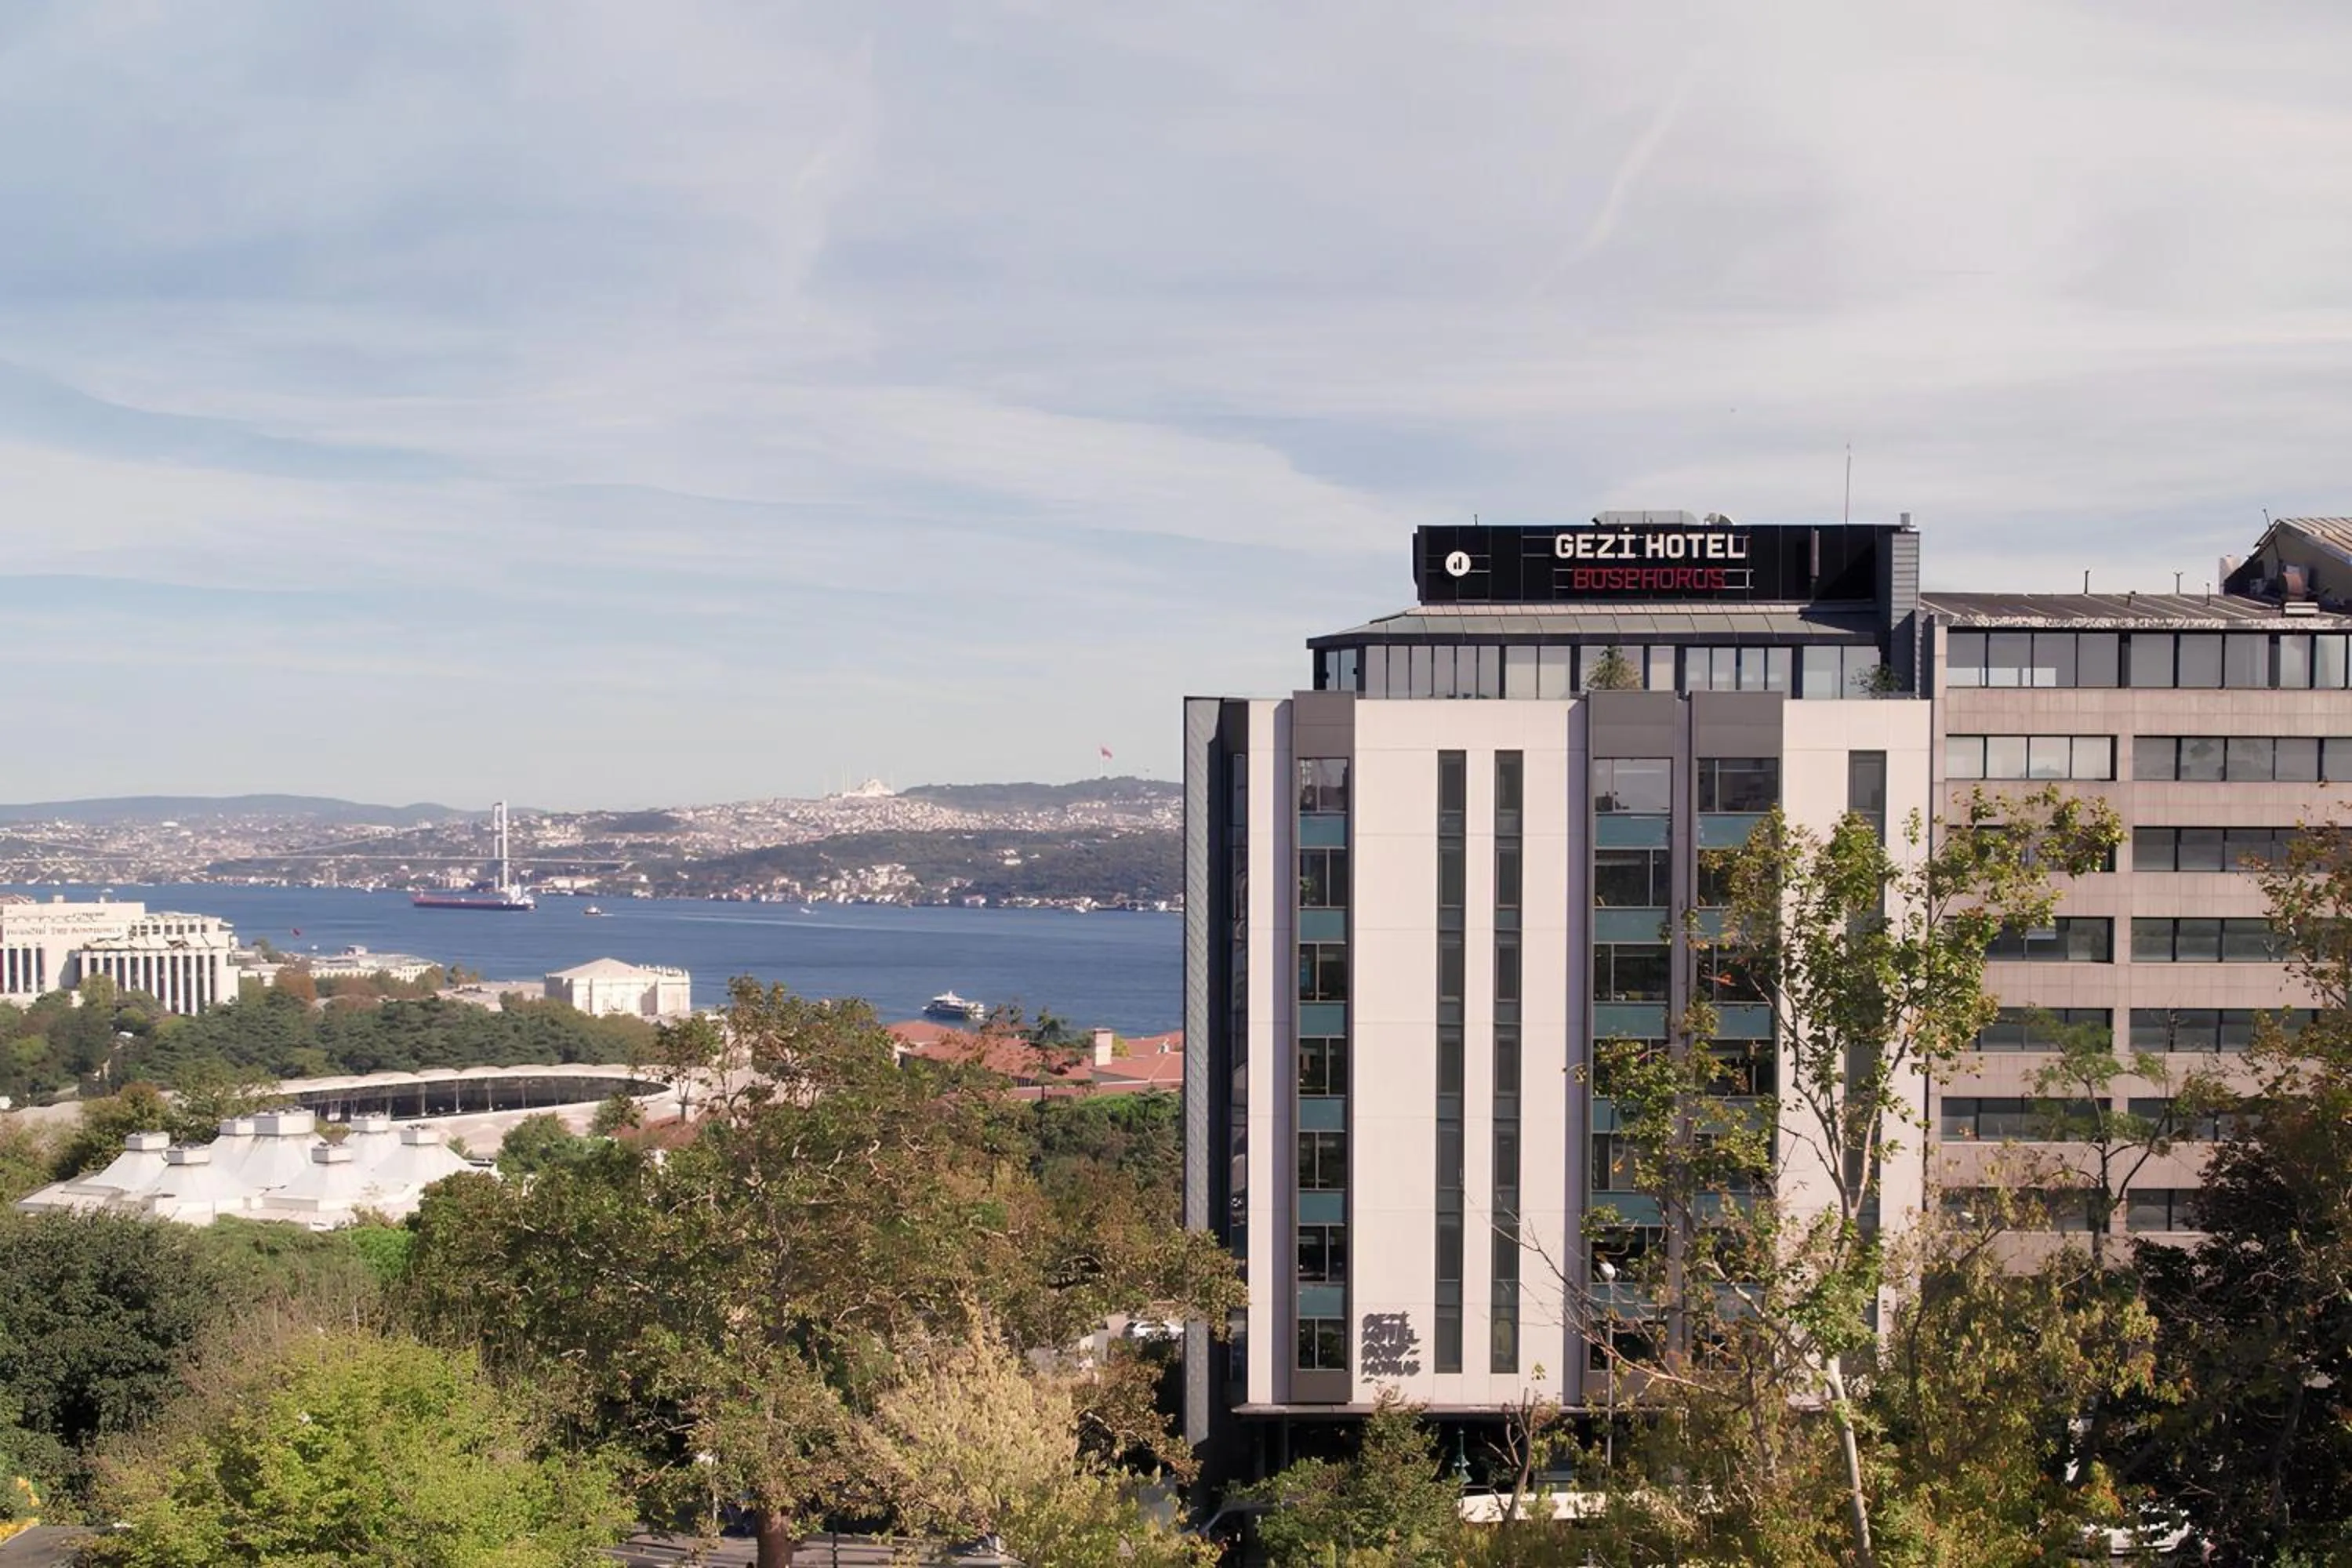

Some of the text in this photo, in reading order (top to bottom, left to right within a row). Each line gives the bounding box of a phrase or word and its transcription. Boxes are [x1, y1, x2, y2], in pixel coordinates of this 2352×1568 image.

[1555, 527, 1746, 559] GEZİ HOTEL
[1573, 568, 1725, 589] BOSPHORUS
